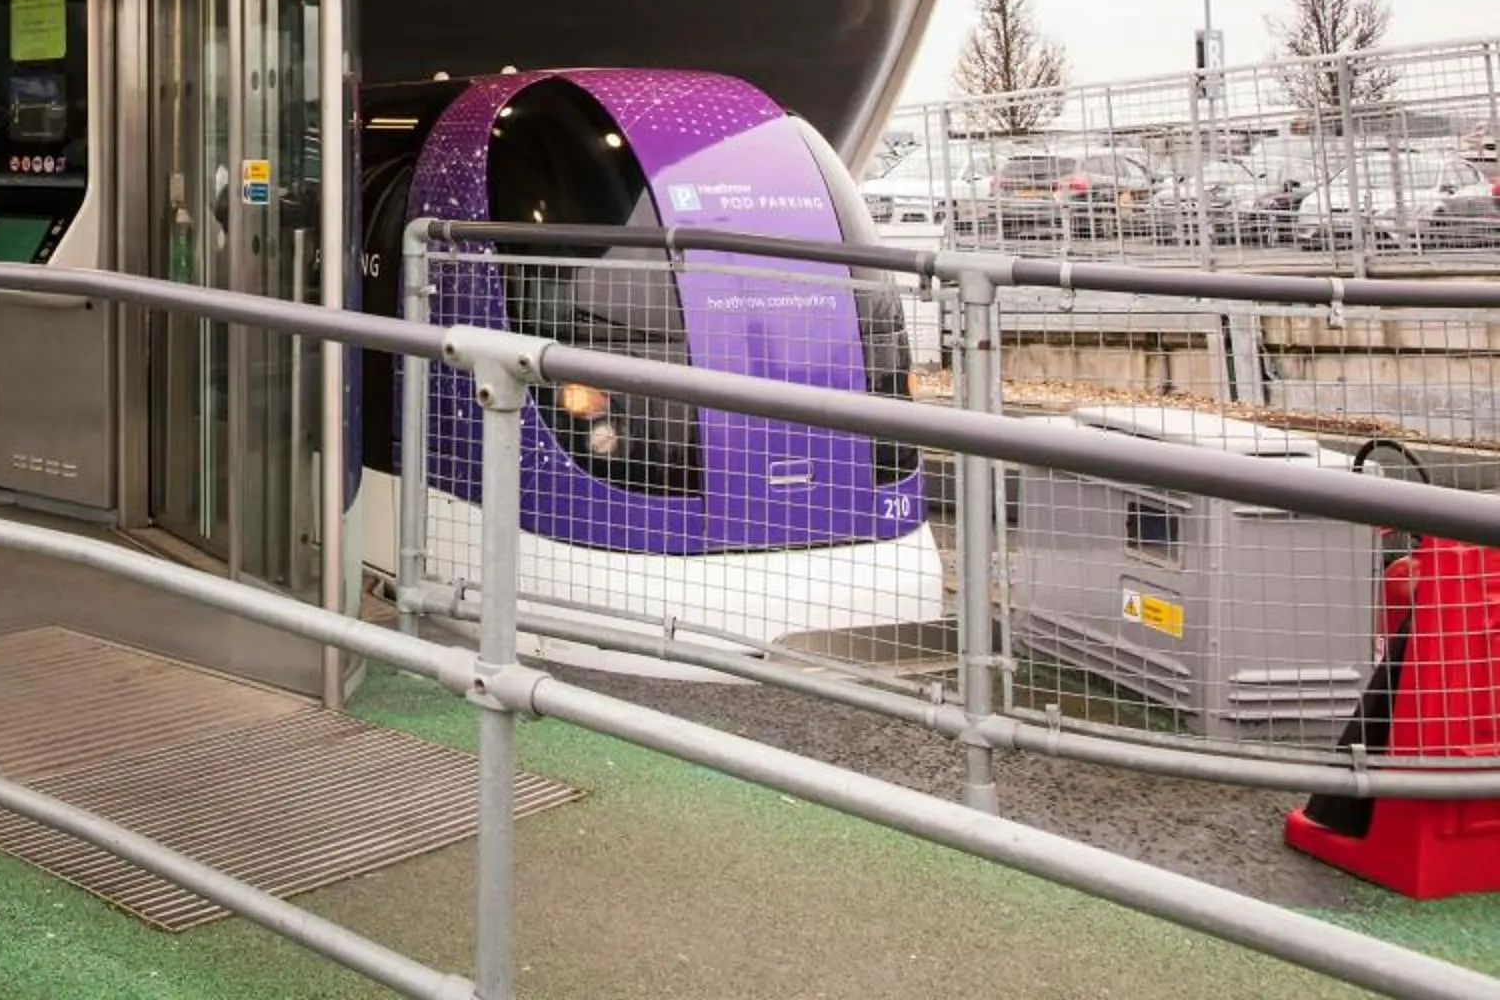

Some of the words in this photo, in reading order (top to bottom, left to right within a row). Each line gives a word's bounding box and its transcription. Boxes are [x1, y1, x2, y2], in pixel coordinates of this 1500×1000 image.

[719, 196, 754, 210] POD
[760, 197, 824, 211] PARKING
[883, 494, 911, 519] 210
